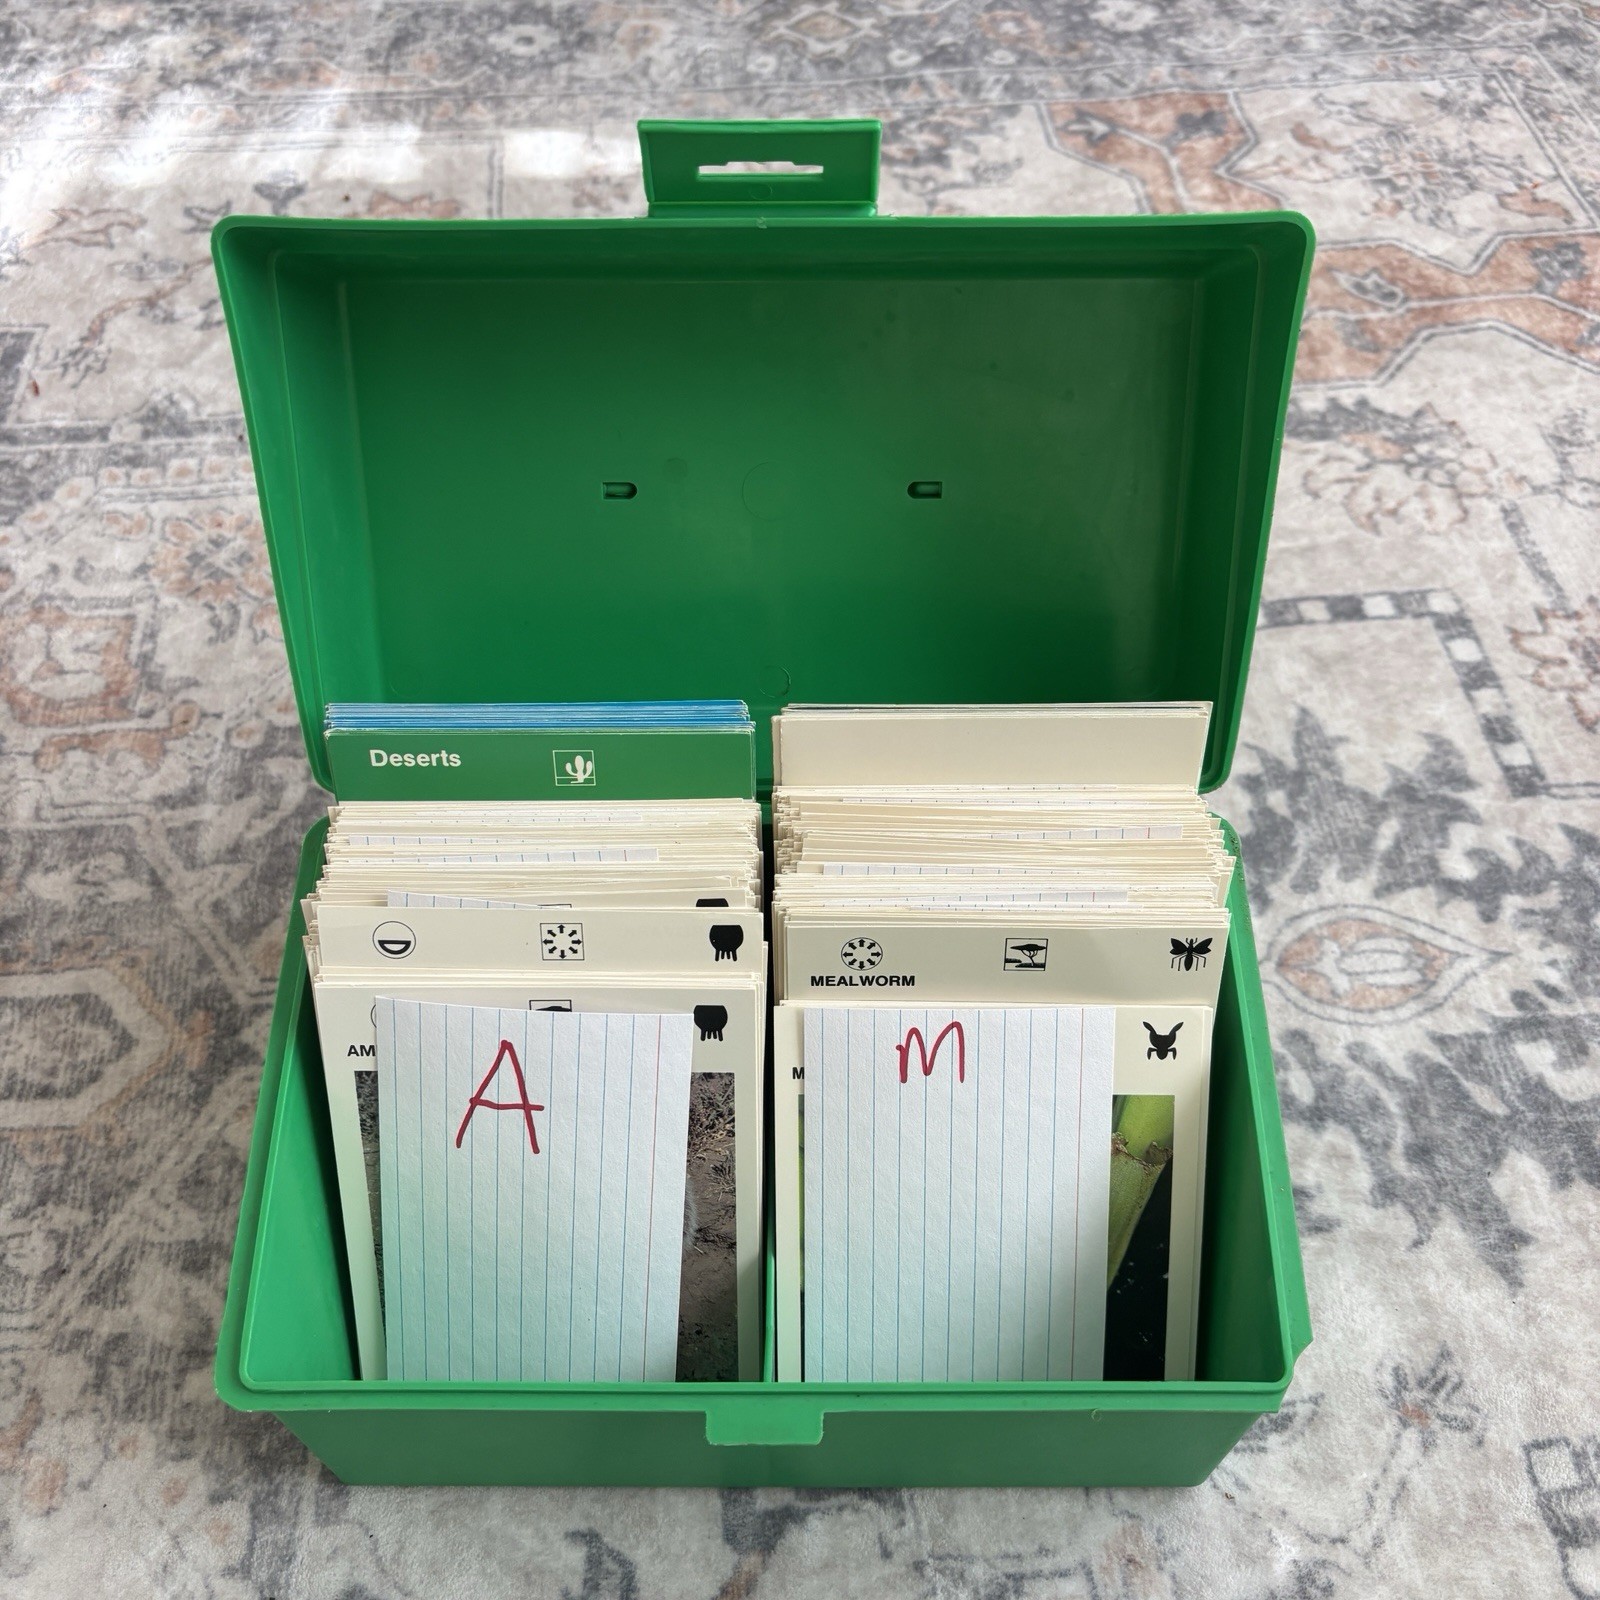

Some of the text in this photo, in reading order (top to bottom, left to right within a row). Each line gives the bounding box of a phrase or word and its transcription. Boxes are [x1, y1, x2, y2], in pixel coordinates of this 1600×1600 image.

[369, 749, 462, 767] Deserts
[810, 975, 916, 987] MEALWORM
[455, 1039, 545, 1155] A
